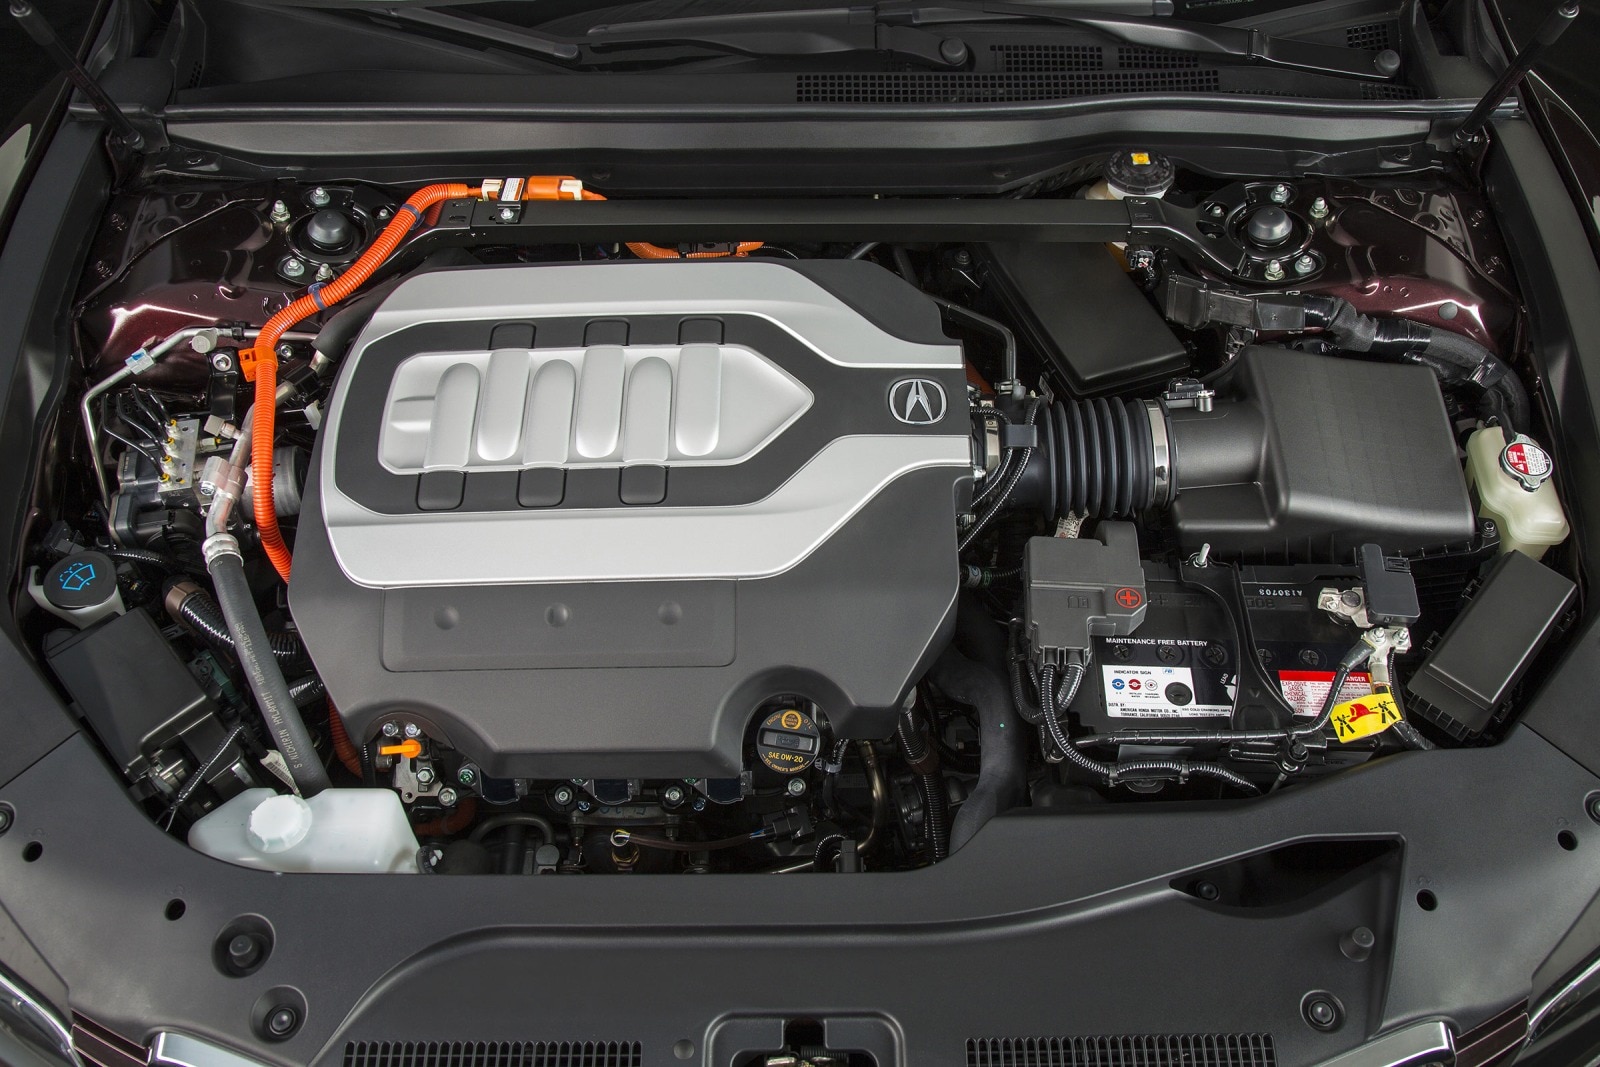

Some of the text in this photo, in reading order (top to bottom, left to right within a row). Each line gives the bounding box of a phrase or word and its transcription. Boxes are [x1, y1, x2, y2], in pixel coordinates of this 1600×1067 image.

[1106, 638, 1156, 646] MAINTENANCE
[766, 714, 781, 726] ENGINE
[804, 719, 813, 729] OIL
[769, 752, 804, 763] SAE 0W-20
